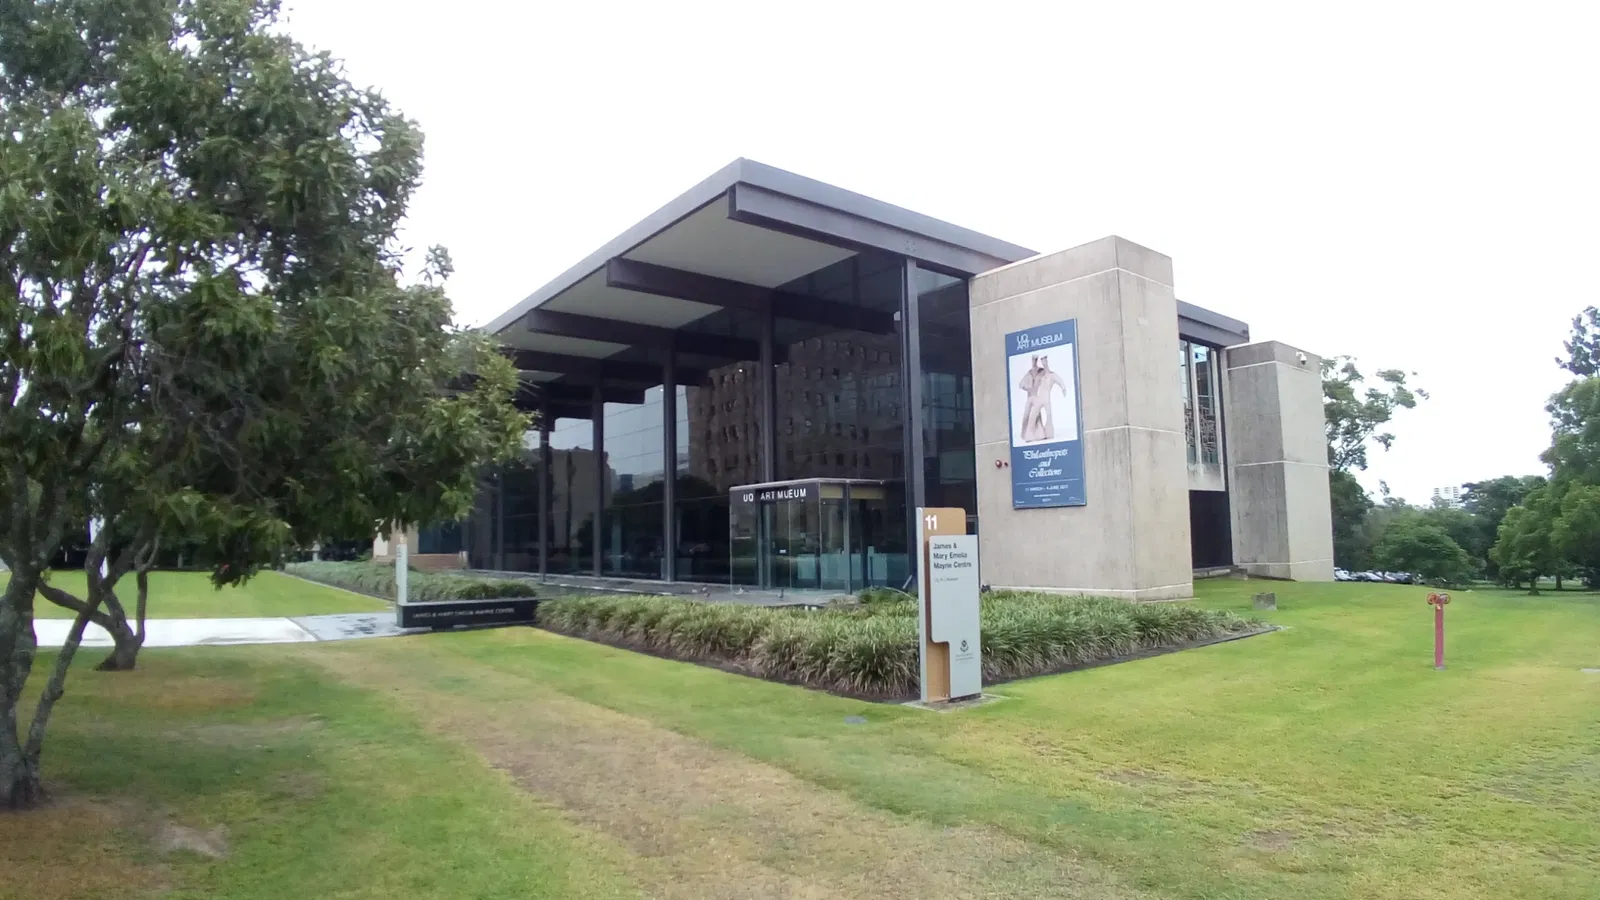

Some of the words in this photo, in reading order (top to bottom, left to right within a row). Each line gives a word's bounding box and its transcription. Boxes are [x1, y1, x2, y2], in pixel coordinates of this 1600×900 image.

[1016, 339, 1029, 350] ART
[1031, 333, 1063, 347] MUSEUM
[743, 493, 754, 502] UQ
[760, 491, 775, 500] ART
[925, 514, 938, 530] 11
[933, 552, 948, 560] Mary
[933, 562, 952, 570] Mayne
